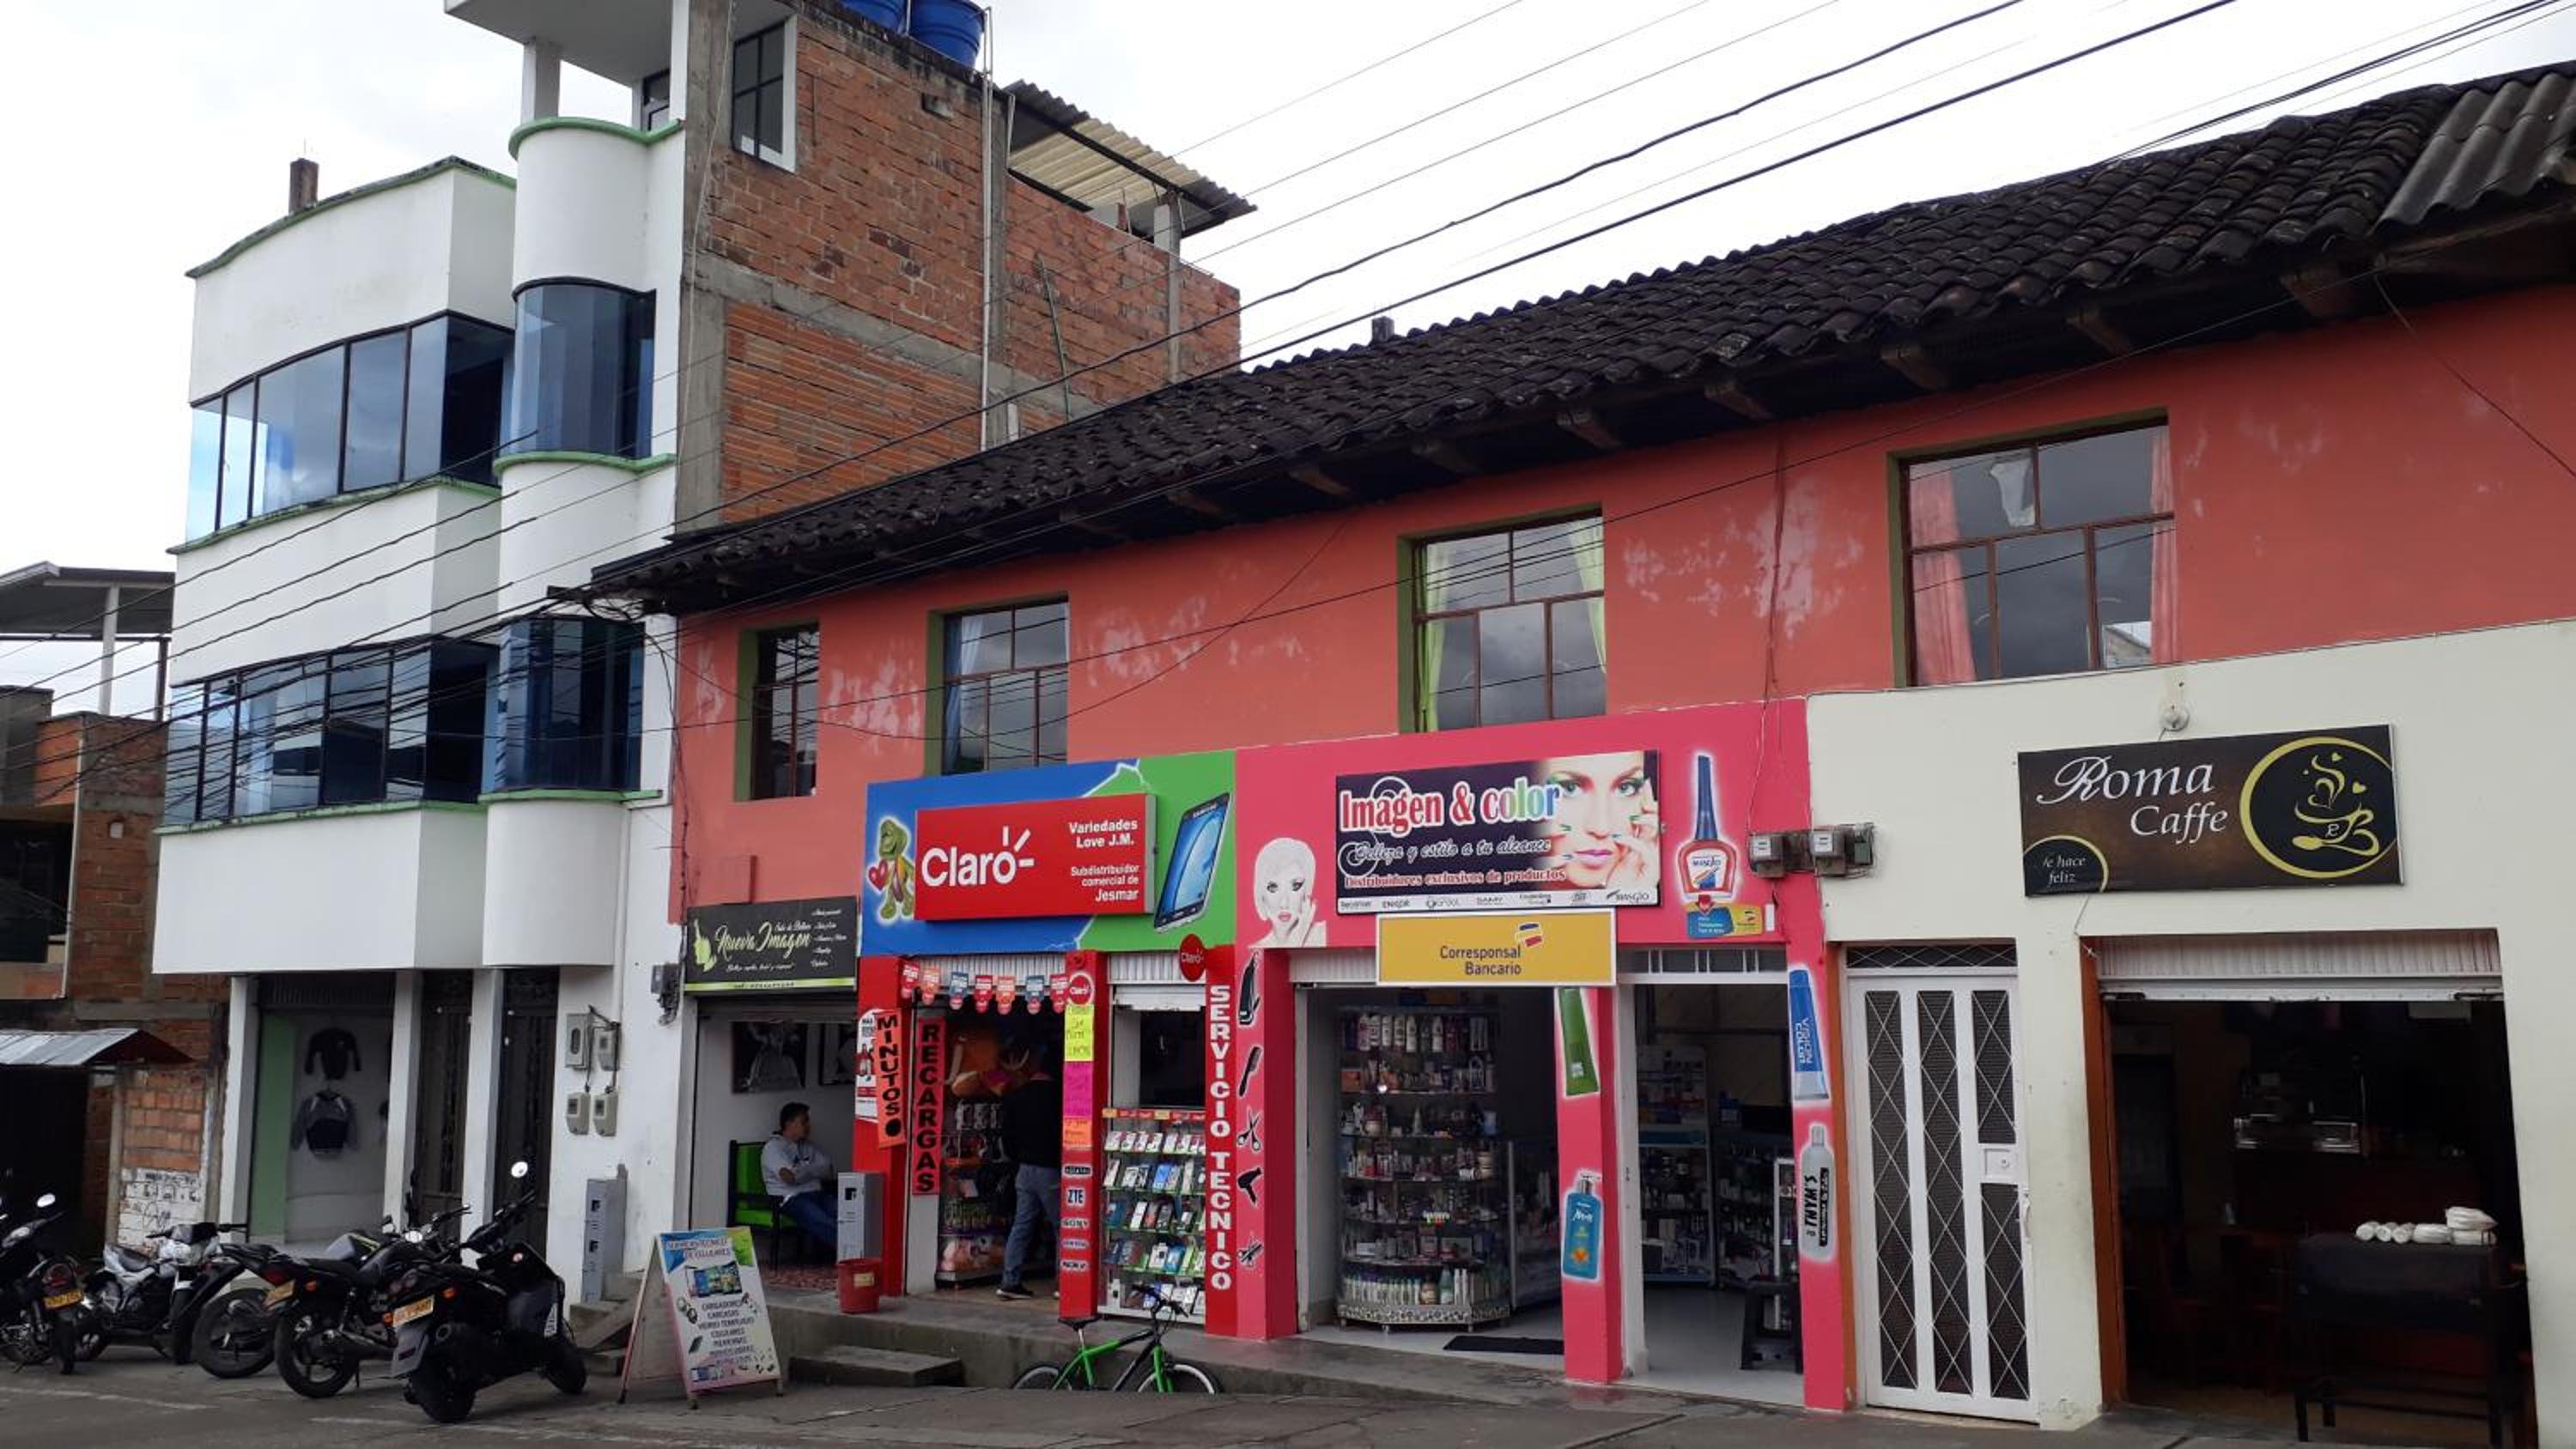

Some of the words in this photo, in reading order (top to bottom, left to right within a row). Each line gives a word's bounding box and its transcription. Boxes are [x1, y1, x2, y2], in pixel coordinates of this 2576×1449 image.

[2036, 755, 2215, 804] Roma
[1340, 791, 1444, 838] Imagen
[1449, 781, 1476, 827] &
[1481, 777, 1562, 823] color
[1069, 819, 1139, 834] Variedades
[2130, 801, 2228, 845] Caffe
[1076, 835, 1106, 848] Love
[1461, 842, 1474, 856] a
[921, 846, 1018, 887] Claro
[1071, 864, 1140, 876] Subdistribuidor
[1082, 876, 1126, 886] comercial
[1127, 875, 1139, 885] de
[1485, 869, 1503, 883] de
[1504, 867, 1567, 885] productos
[1095, 888, 1139, 902] Jesmar
[756, 922, 811, 959] Imagen
[1440, 944, 1521, 961] Corresponsal
[1465, 961, 1522, 975] Bancario
[877, 1015, 902, 1115] MINUTOS
[1210, 985, 1230, 1138] SERVICIO
[916, 1024, 941, 1192] RECARGAS
[1067, 1189, 1084, 1203] ZTE
[1210, 1151, 1232, 1290] TECNICO
